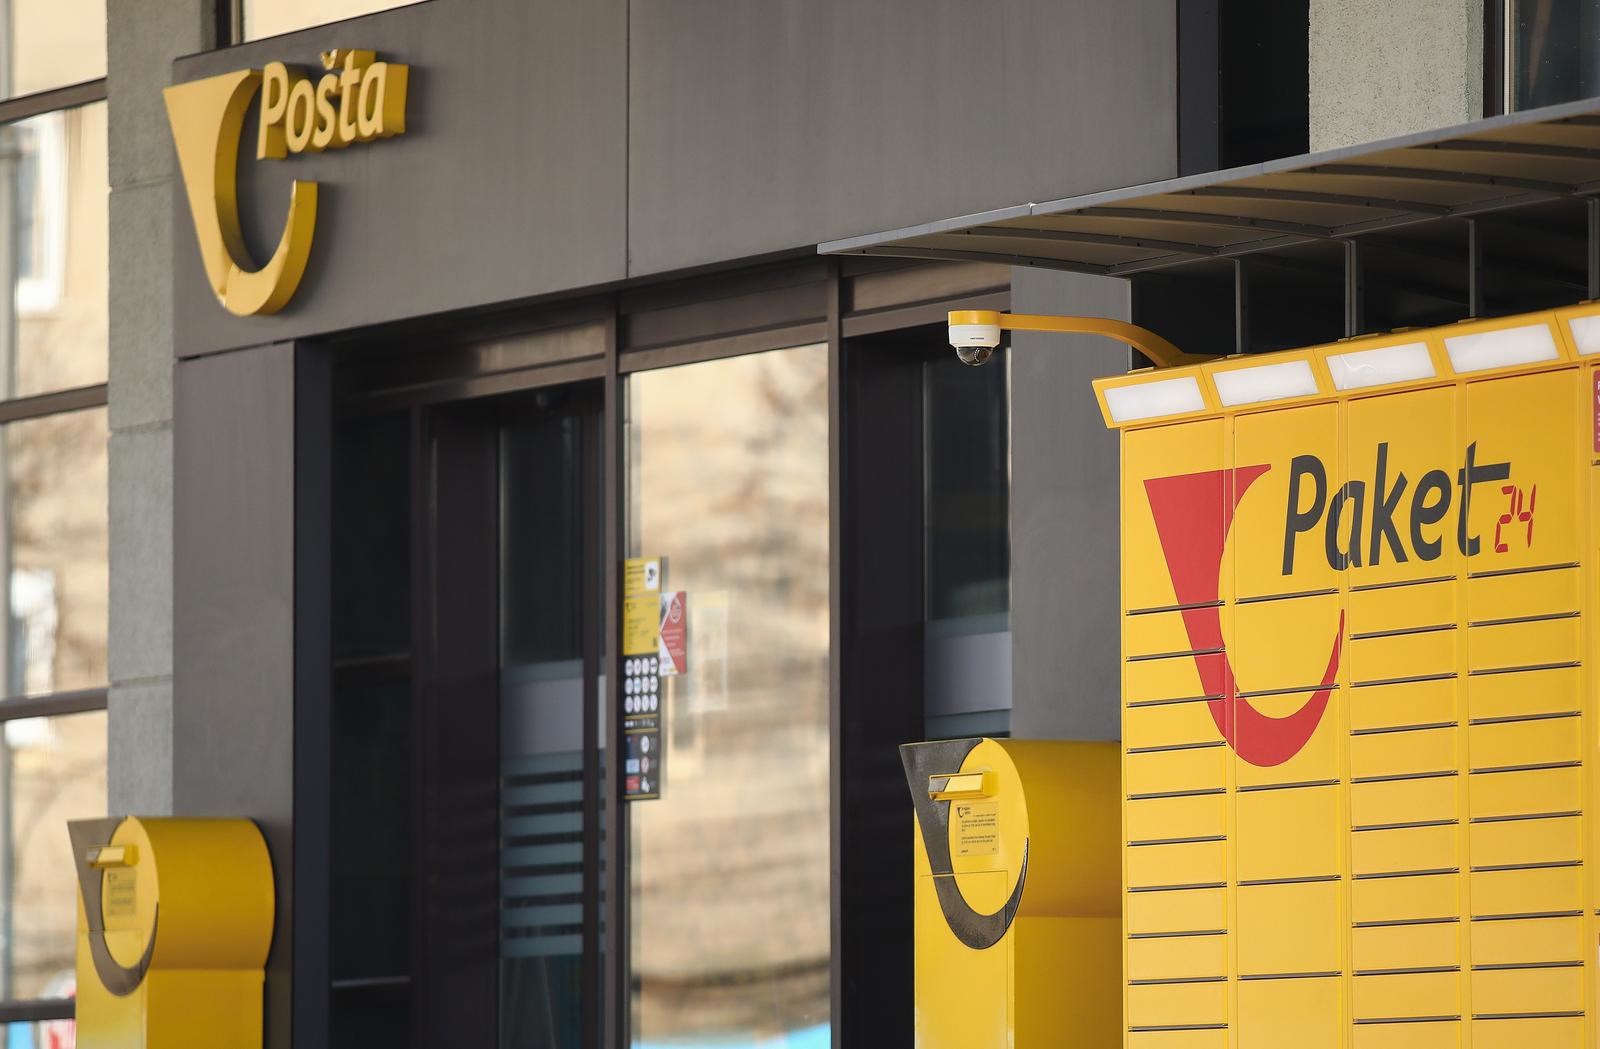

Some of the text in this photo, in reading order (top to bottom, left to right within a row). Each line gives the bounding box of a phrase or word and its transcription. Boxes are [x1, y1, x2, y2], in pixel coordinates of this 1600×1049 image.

[257, 49, 408, 160] Pošta
[1282, 440, 1536, 576] Paket 24
